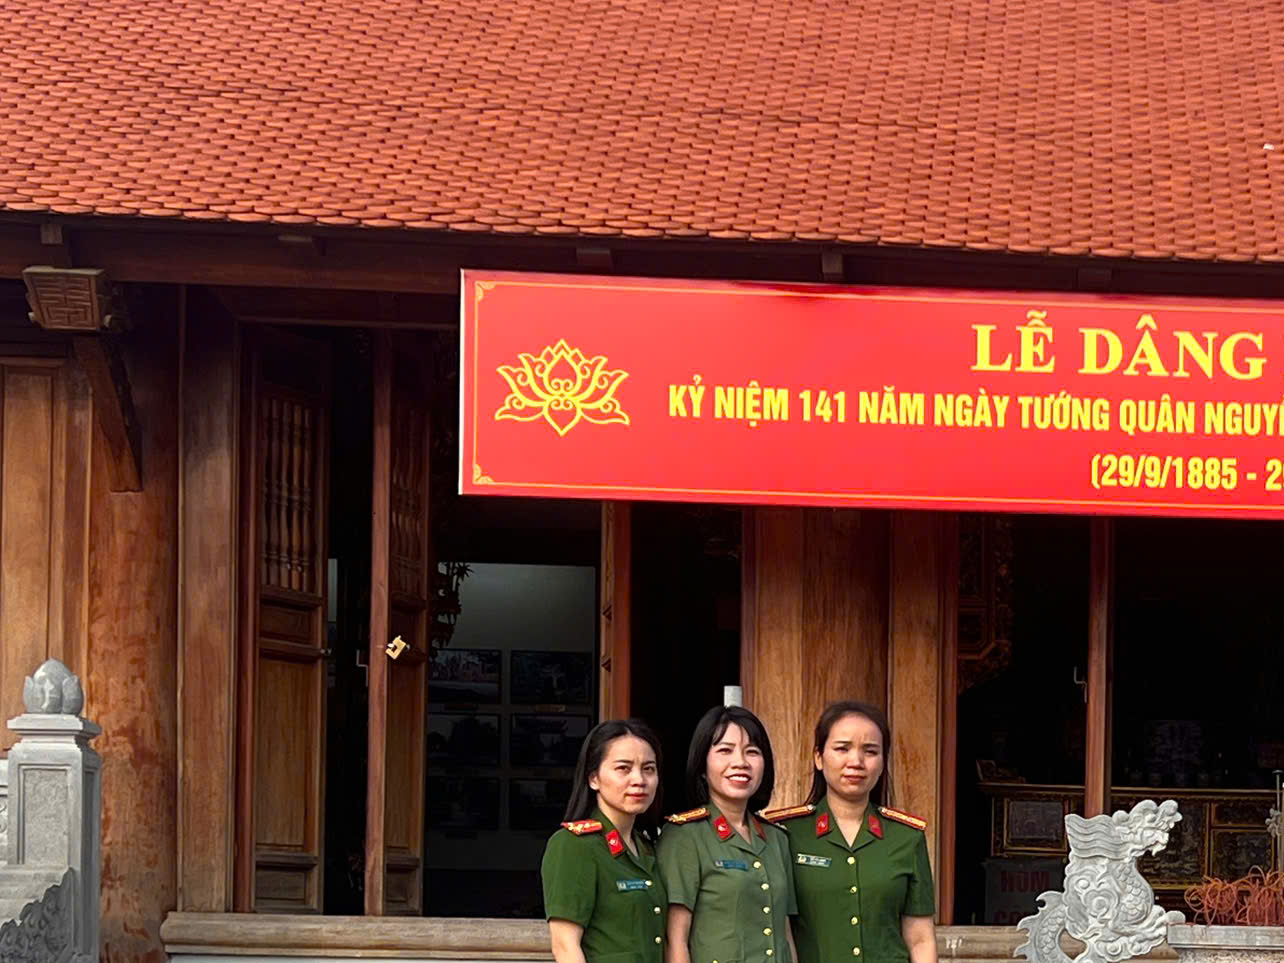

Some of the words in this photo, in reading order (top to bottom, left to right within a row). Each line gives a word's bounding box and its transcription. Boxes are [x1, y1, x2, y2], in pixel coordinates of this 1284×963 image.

[970, 309, 1056, 374] LỄ
[1077, 314, 1268, 381] DÂNG
[668, 373, 706, 418] KỶ
[714, 380, 789, 428] NIỆM
[798, 389, 846, 423] 141
[858, 385, 925, 426] NĂM
[933, 387, 1010, 428] NGÀY
[1017, 390, 1110, 431] TƯỚNG
[1119, 393, 1196, 436] QUÂN
[1091, 453, 1238, 490] (29/9/1885
[1246, 472, 1257, 481] -
